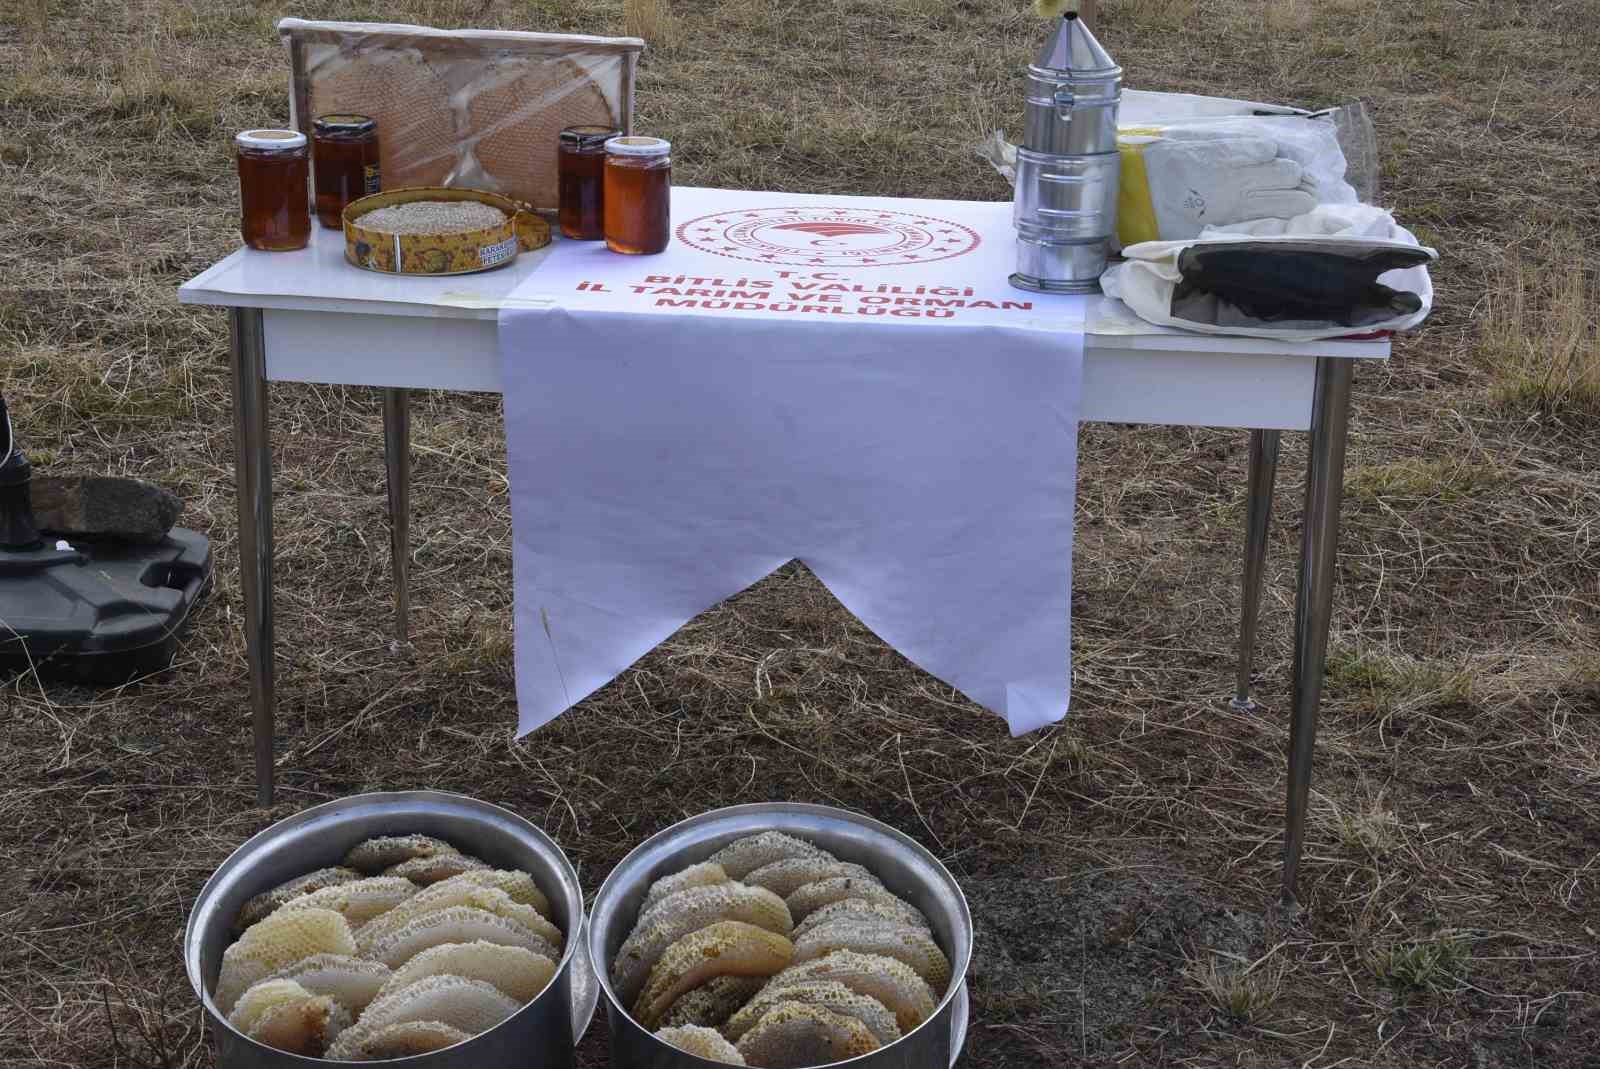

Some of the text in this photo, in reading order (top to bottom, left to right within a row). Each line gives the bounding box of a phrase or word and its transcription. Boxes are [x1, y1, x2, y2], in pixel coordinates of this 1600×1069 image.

[644, 274, 974, 297] BİTLİS VALİLİĞİ
[774, 270, 850, 281] T.C.
[576, 280, 1033, 311] İL TARIM VE ORMAN
[655, 298, 956, 318] MÜDÜRLÜĞÜ
